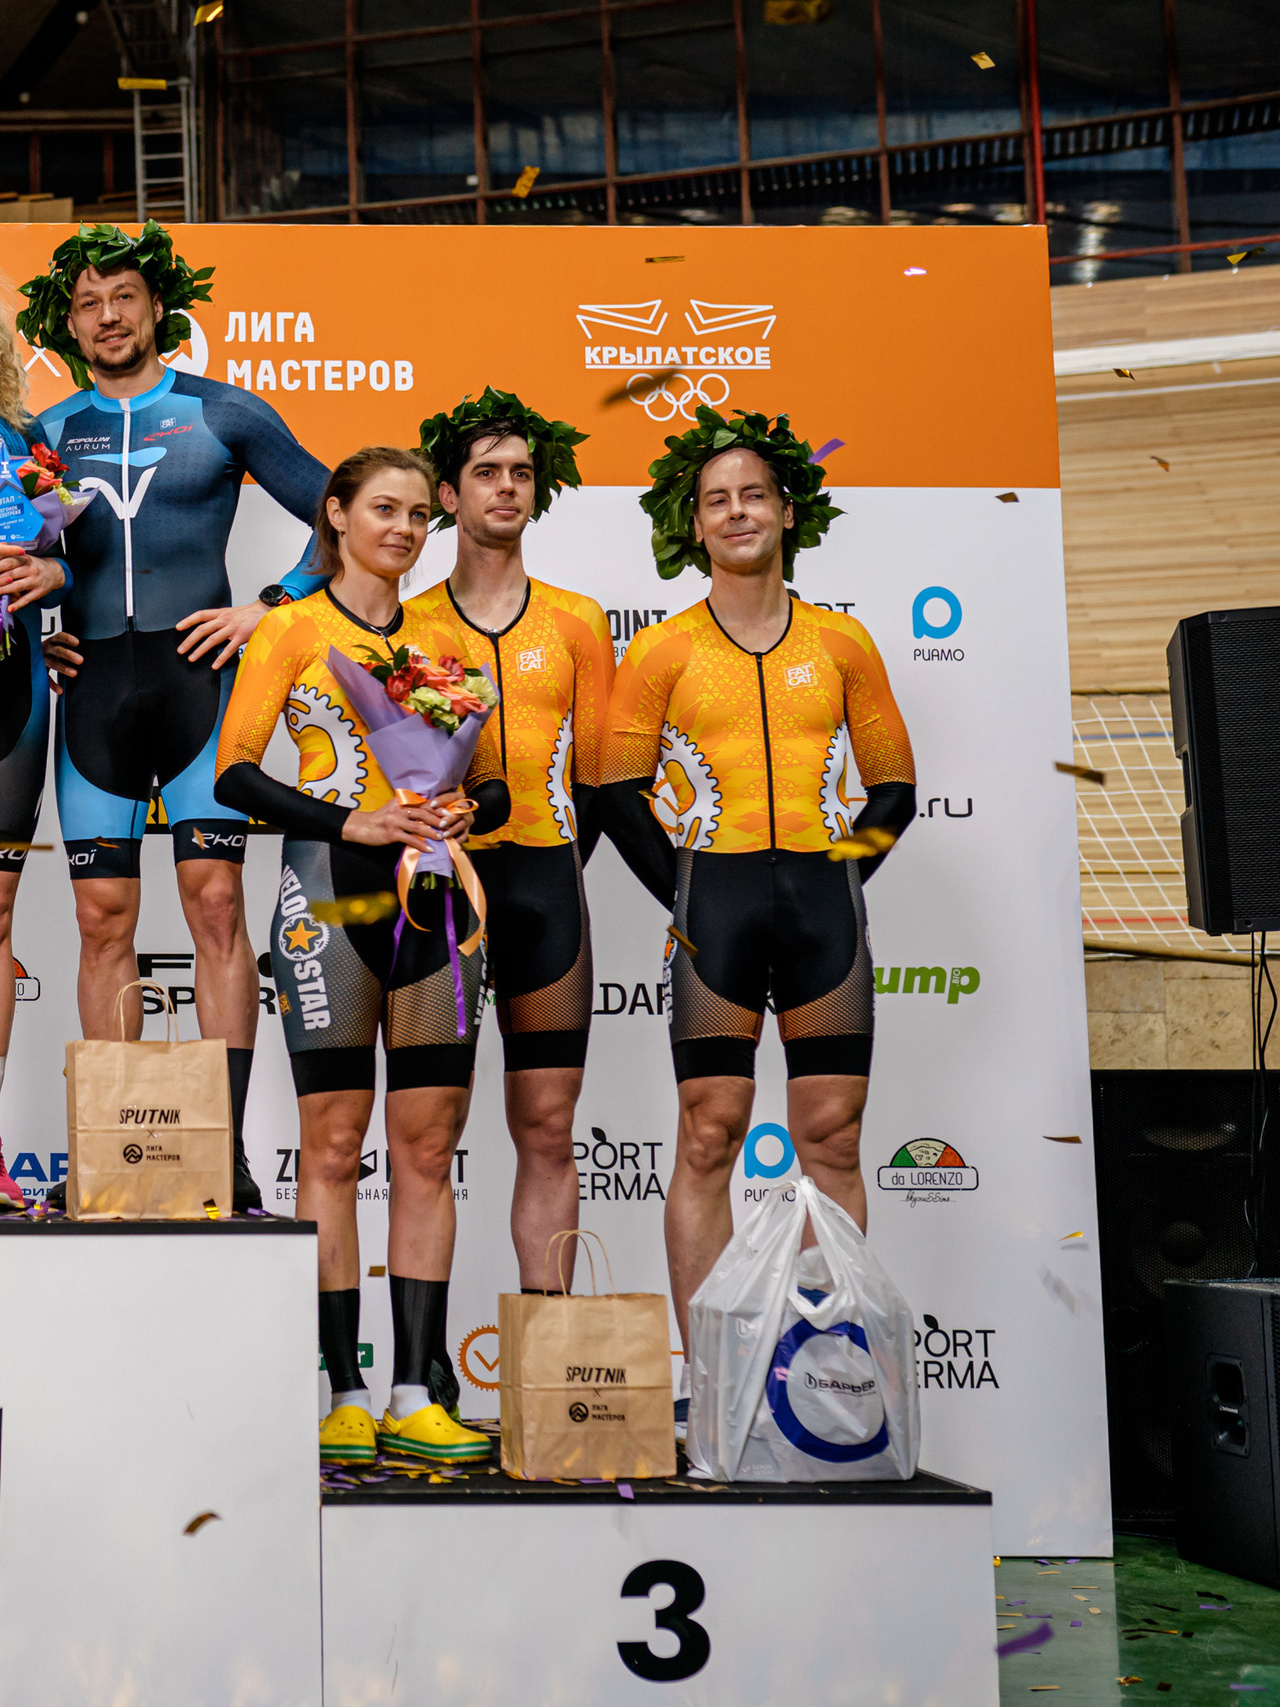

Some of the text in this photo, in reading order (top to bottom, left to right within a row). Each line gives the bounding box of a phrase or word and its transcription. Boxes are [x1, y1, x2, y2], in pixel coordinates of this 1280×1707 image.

[224, 311, 315, 342] ЛИГА
[585, 346, 771, 366] КРЫЛАТСКОЕ
[226, 359, 415, 391] МАСТЕРОВ
[65, 444, 111, 452] AURUM
[606, 610, 667, 642] OINT
[519, 649, 543, 663] FAT
[914, 649, 965, 661] PUAMO
[519, 659, 544, 672] CAT
[787, 664, 811, 678] FAT
[874, 966, 981, 1005] ump
[293, 959, 331, 1031] STAR
[119, 1109, 181, 1124] SPUTNIK
[146, 1154, 181, 1162] МАСТЕРОВ
[573, 1142, 663, 1170] PORT
[579, 1172, 666, 1201] ERMA
[891, 1172, 963, 1186] da LORENZO
[565, 1366, 627, 1384] SPUTNIK
[591, 1413, 626, 1421] МАСТЕРОВ
[617, 1560, 710, 1682] 3
